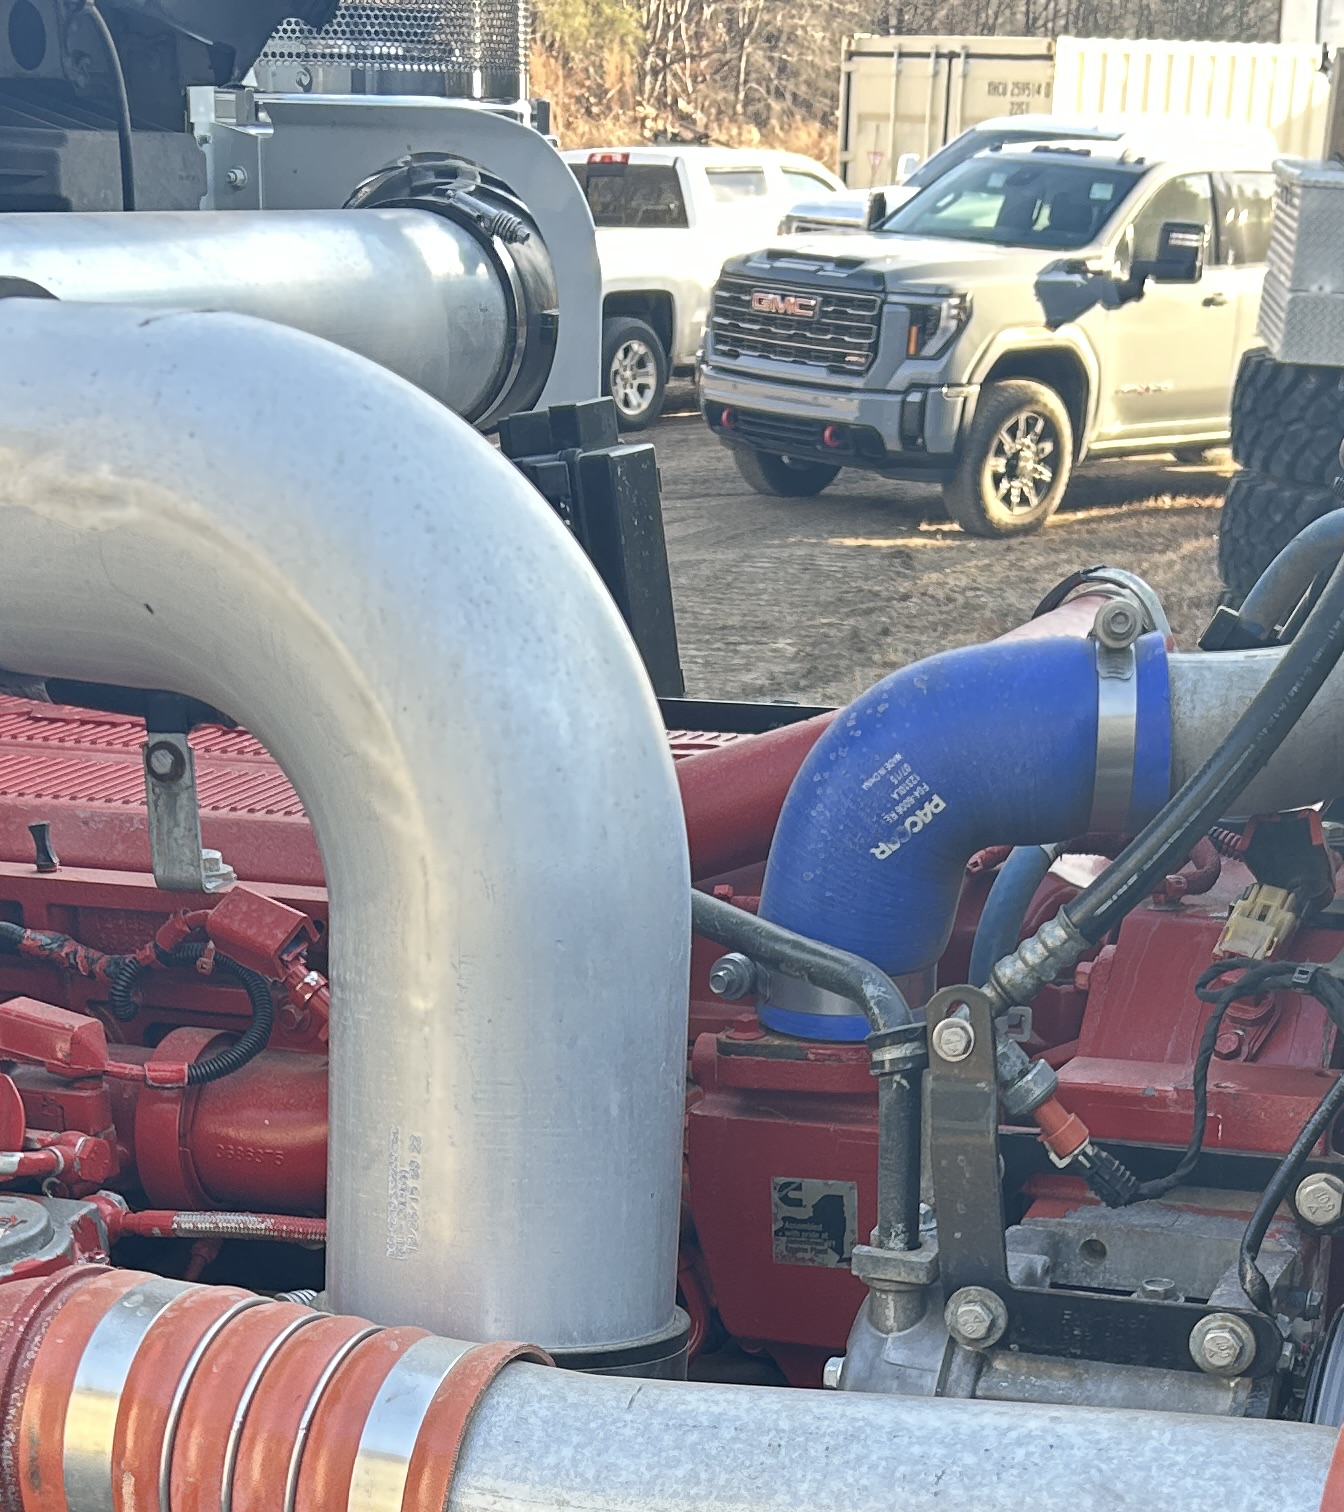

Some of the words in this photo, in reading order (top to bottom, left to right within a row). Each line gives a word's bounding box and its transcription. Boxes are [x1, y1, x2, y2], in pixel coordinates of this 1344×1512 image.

[752, 292, 816, 317] GMC
[884, 752, 903, 771] MADE
[869, 793, 947, 860] PACCAR
